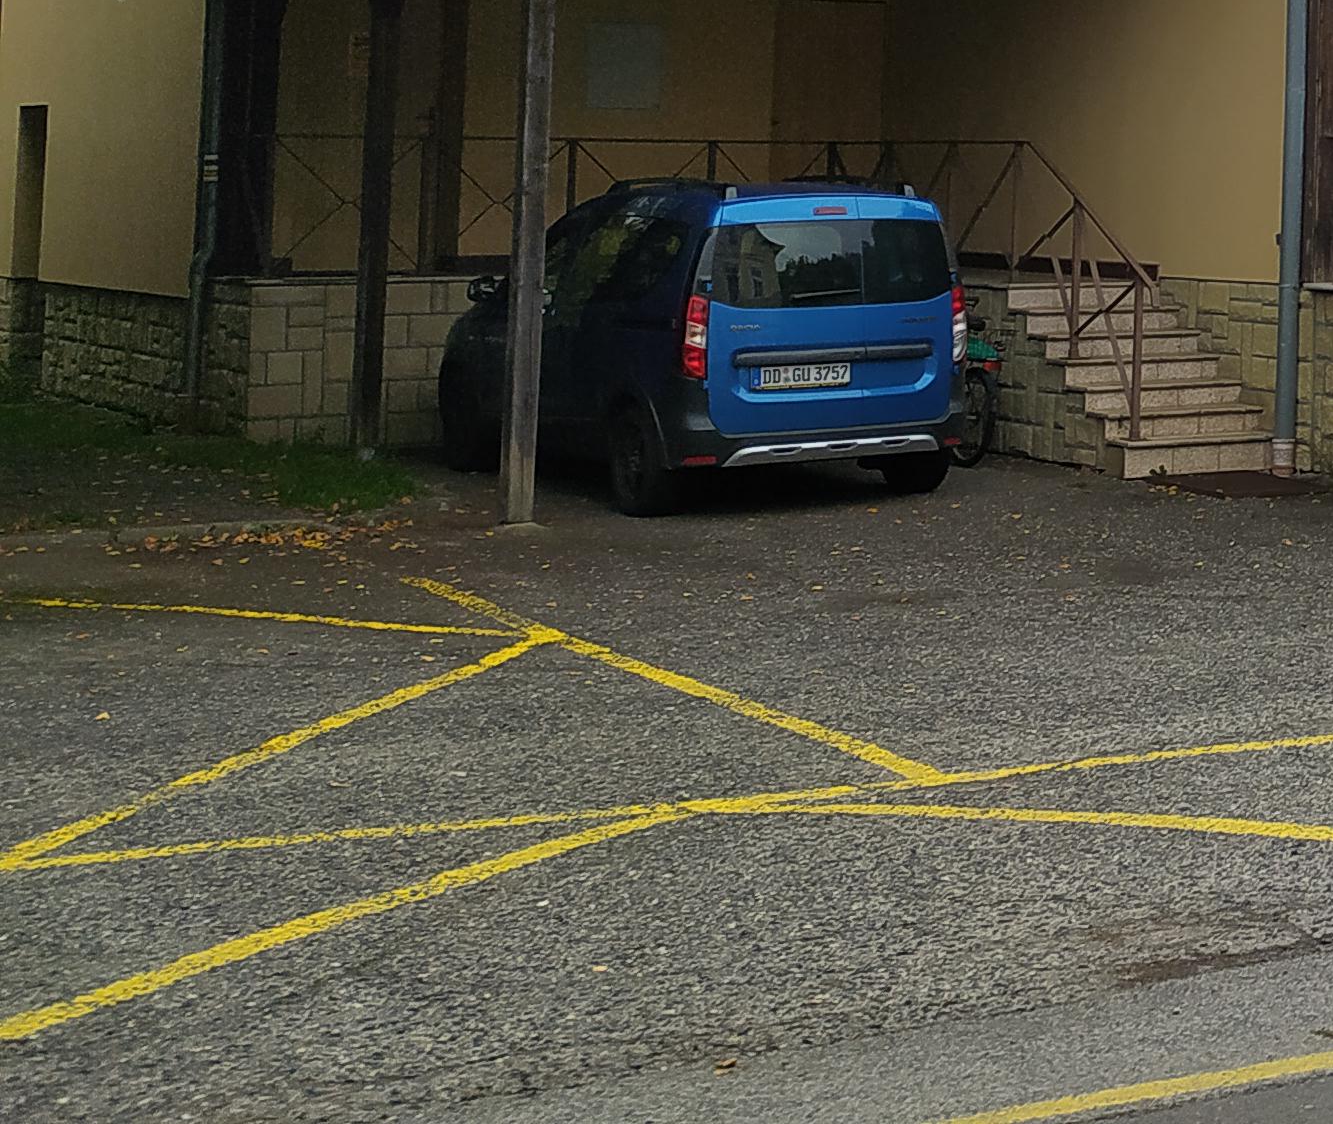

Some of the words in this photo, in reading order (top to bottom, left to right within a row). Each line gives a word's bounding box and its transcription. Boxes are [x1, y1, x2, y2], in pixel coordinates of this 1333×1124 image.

[762, 368, 781, 384] DD
[792, 367, 811, 382] GU
[813, 364, 848, 381] 3757
